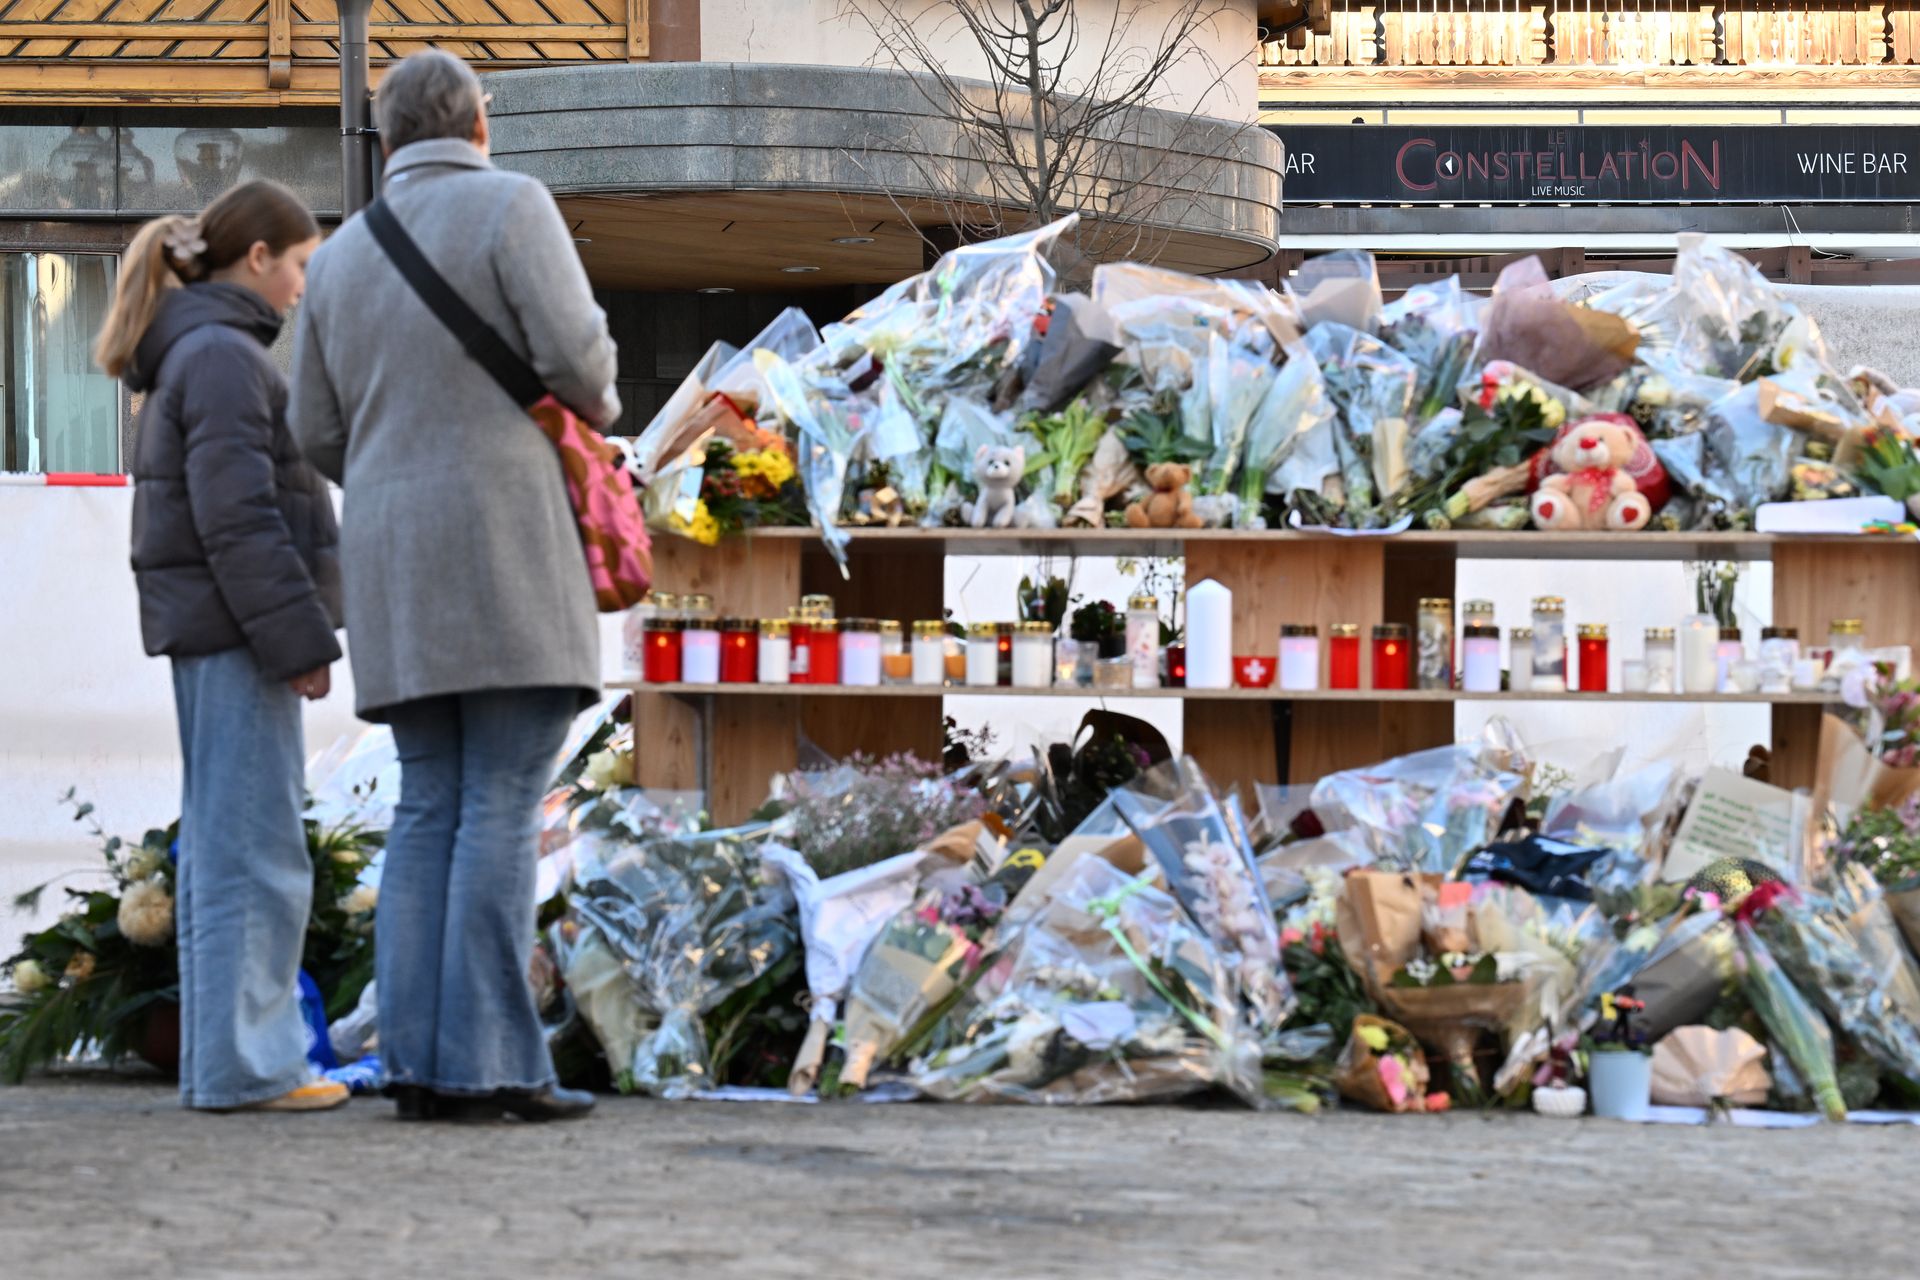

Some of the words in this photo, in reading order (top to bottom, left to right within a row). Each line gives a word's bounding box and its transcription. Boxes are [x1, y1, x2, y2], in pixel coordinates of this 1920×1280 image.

[1549, 131, 1565, 144] LE
[1285, 153, 1315, 174] AR
[1797, 153, 1856, 174] WINE
[1863, 153, 1907, 174] BAR
[1531, 185, 1552, 196] LIVE
[1554, 185, 1585, 196] MUSIC
